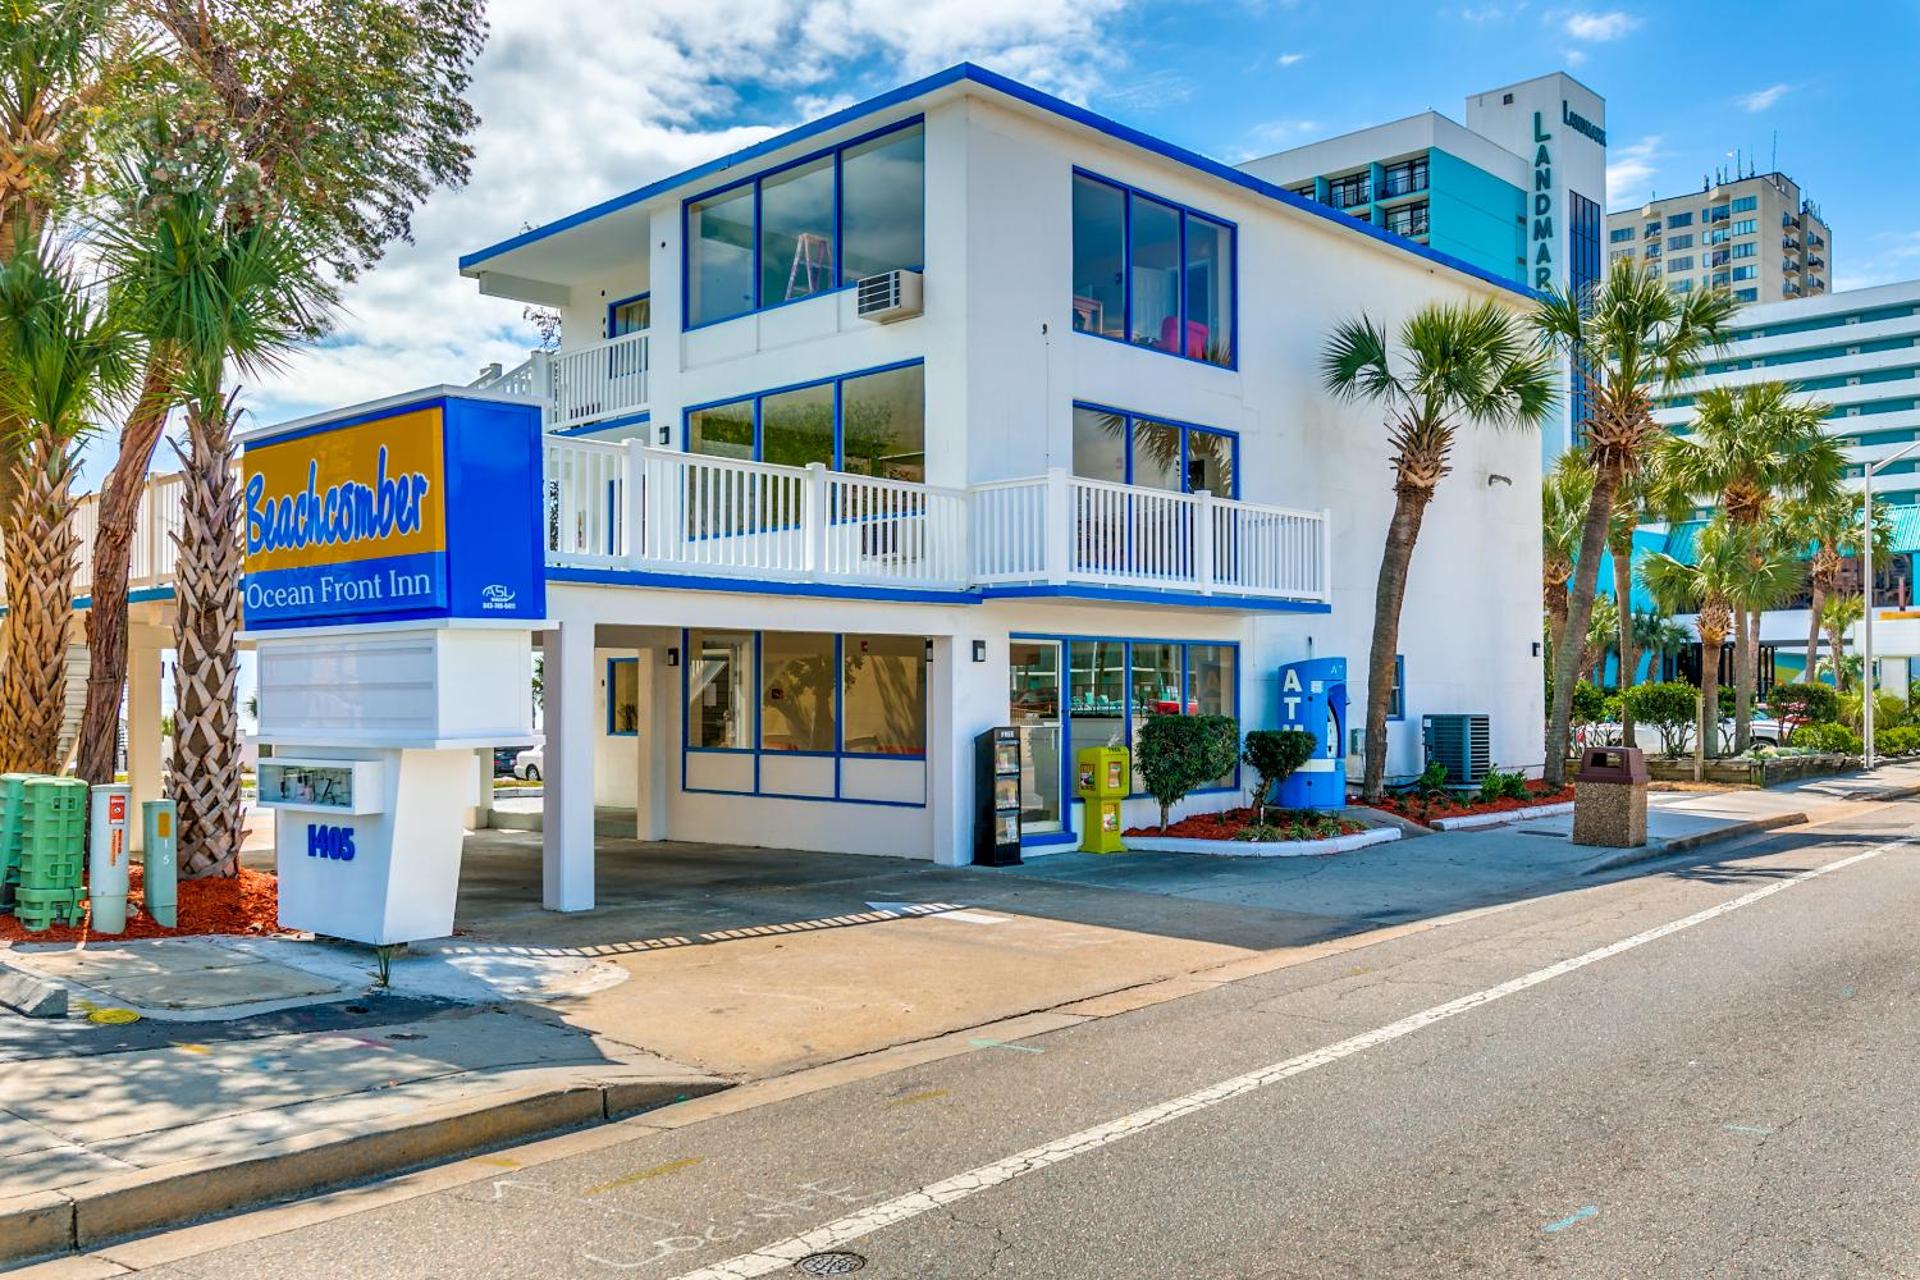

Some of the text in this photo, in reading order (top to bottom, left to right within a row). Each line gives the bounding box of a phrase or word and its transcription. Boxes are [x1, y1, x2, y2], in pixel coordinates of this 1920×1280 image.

[1533, 111, 1553, 289] LANDMAR
[245, 443, 430, 557] Beachcomber
[246, 569, 432, 609] Ocean Front Inn
[307, 824, 355, 861] 1405
